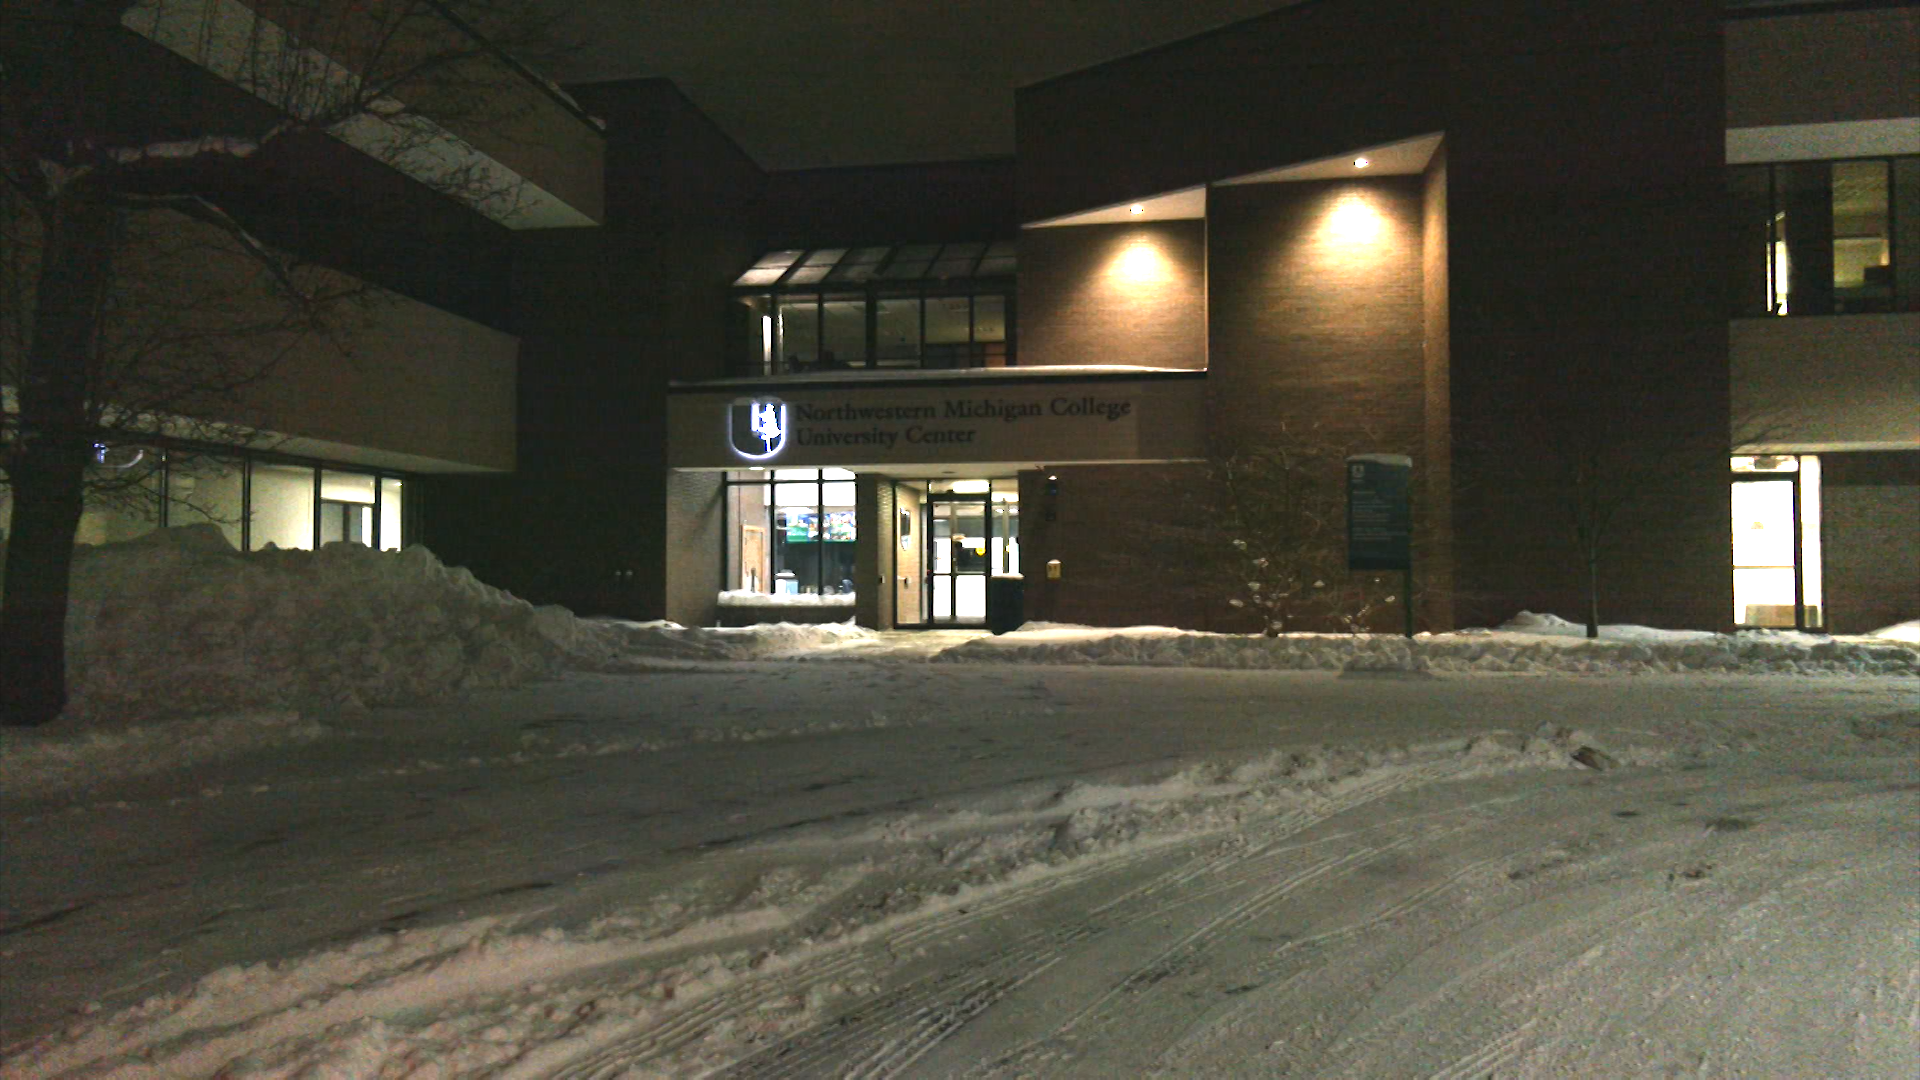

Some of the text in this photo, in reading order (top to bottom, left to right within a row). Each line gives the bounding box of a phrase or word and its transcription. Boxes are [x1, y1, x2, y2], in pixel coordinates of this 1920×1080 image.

[797, 397, 1132, 422] Northwestern Michigan College
[797, 424, 976, 449] University Center
